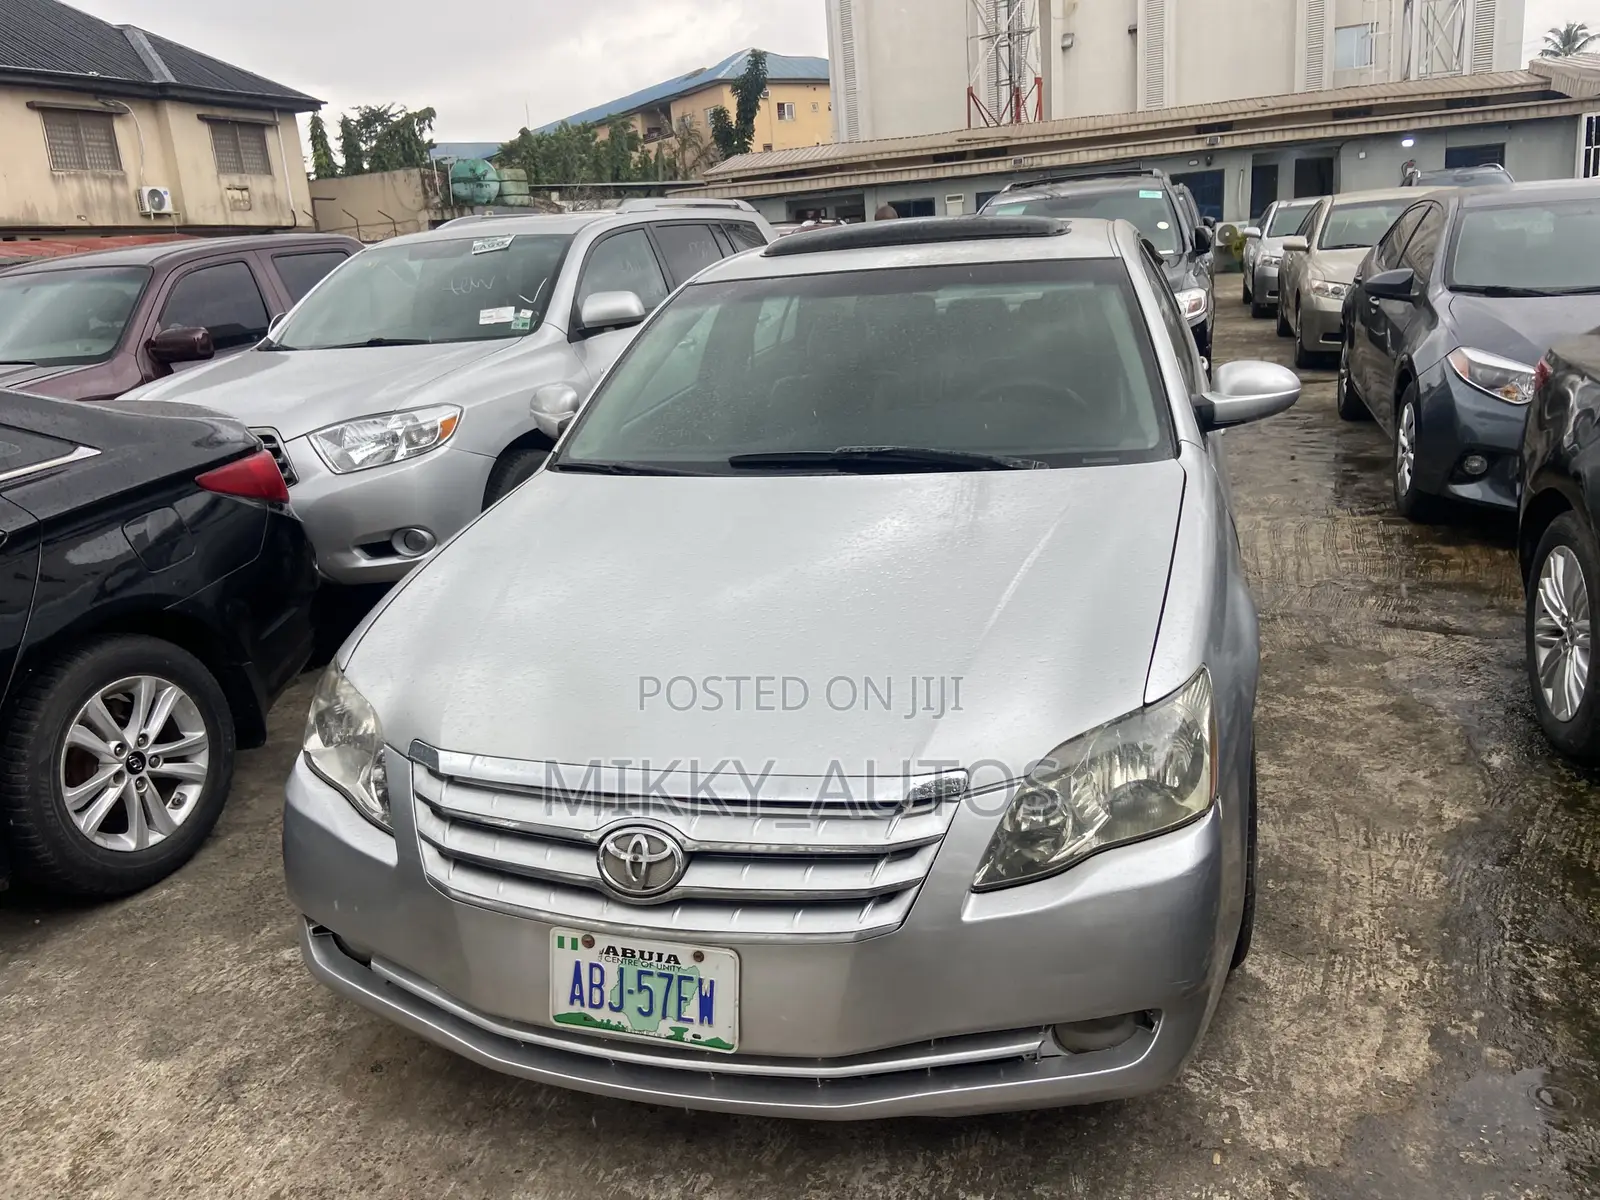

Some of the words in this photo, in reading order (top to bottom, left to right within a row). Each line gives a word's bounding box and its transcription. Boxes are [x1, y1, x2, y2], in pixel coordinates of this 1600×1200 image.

[604, 945, 682, 965] ABUJA
[604, 956, 639, 967] CENTRE
[640, 960, 655, 969] OF
[656, 963, 682, 973] UNITY
[569, 959, 716, 1027] ABJ-57EW
